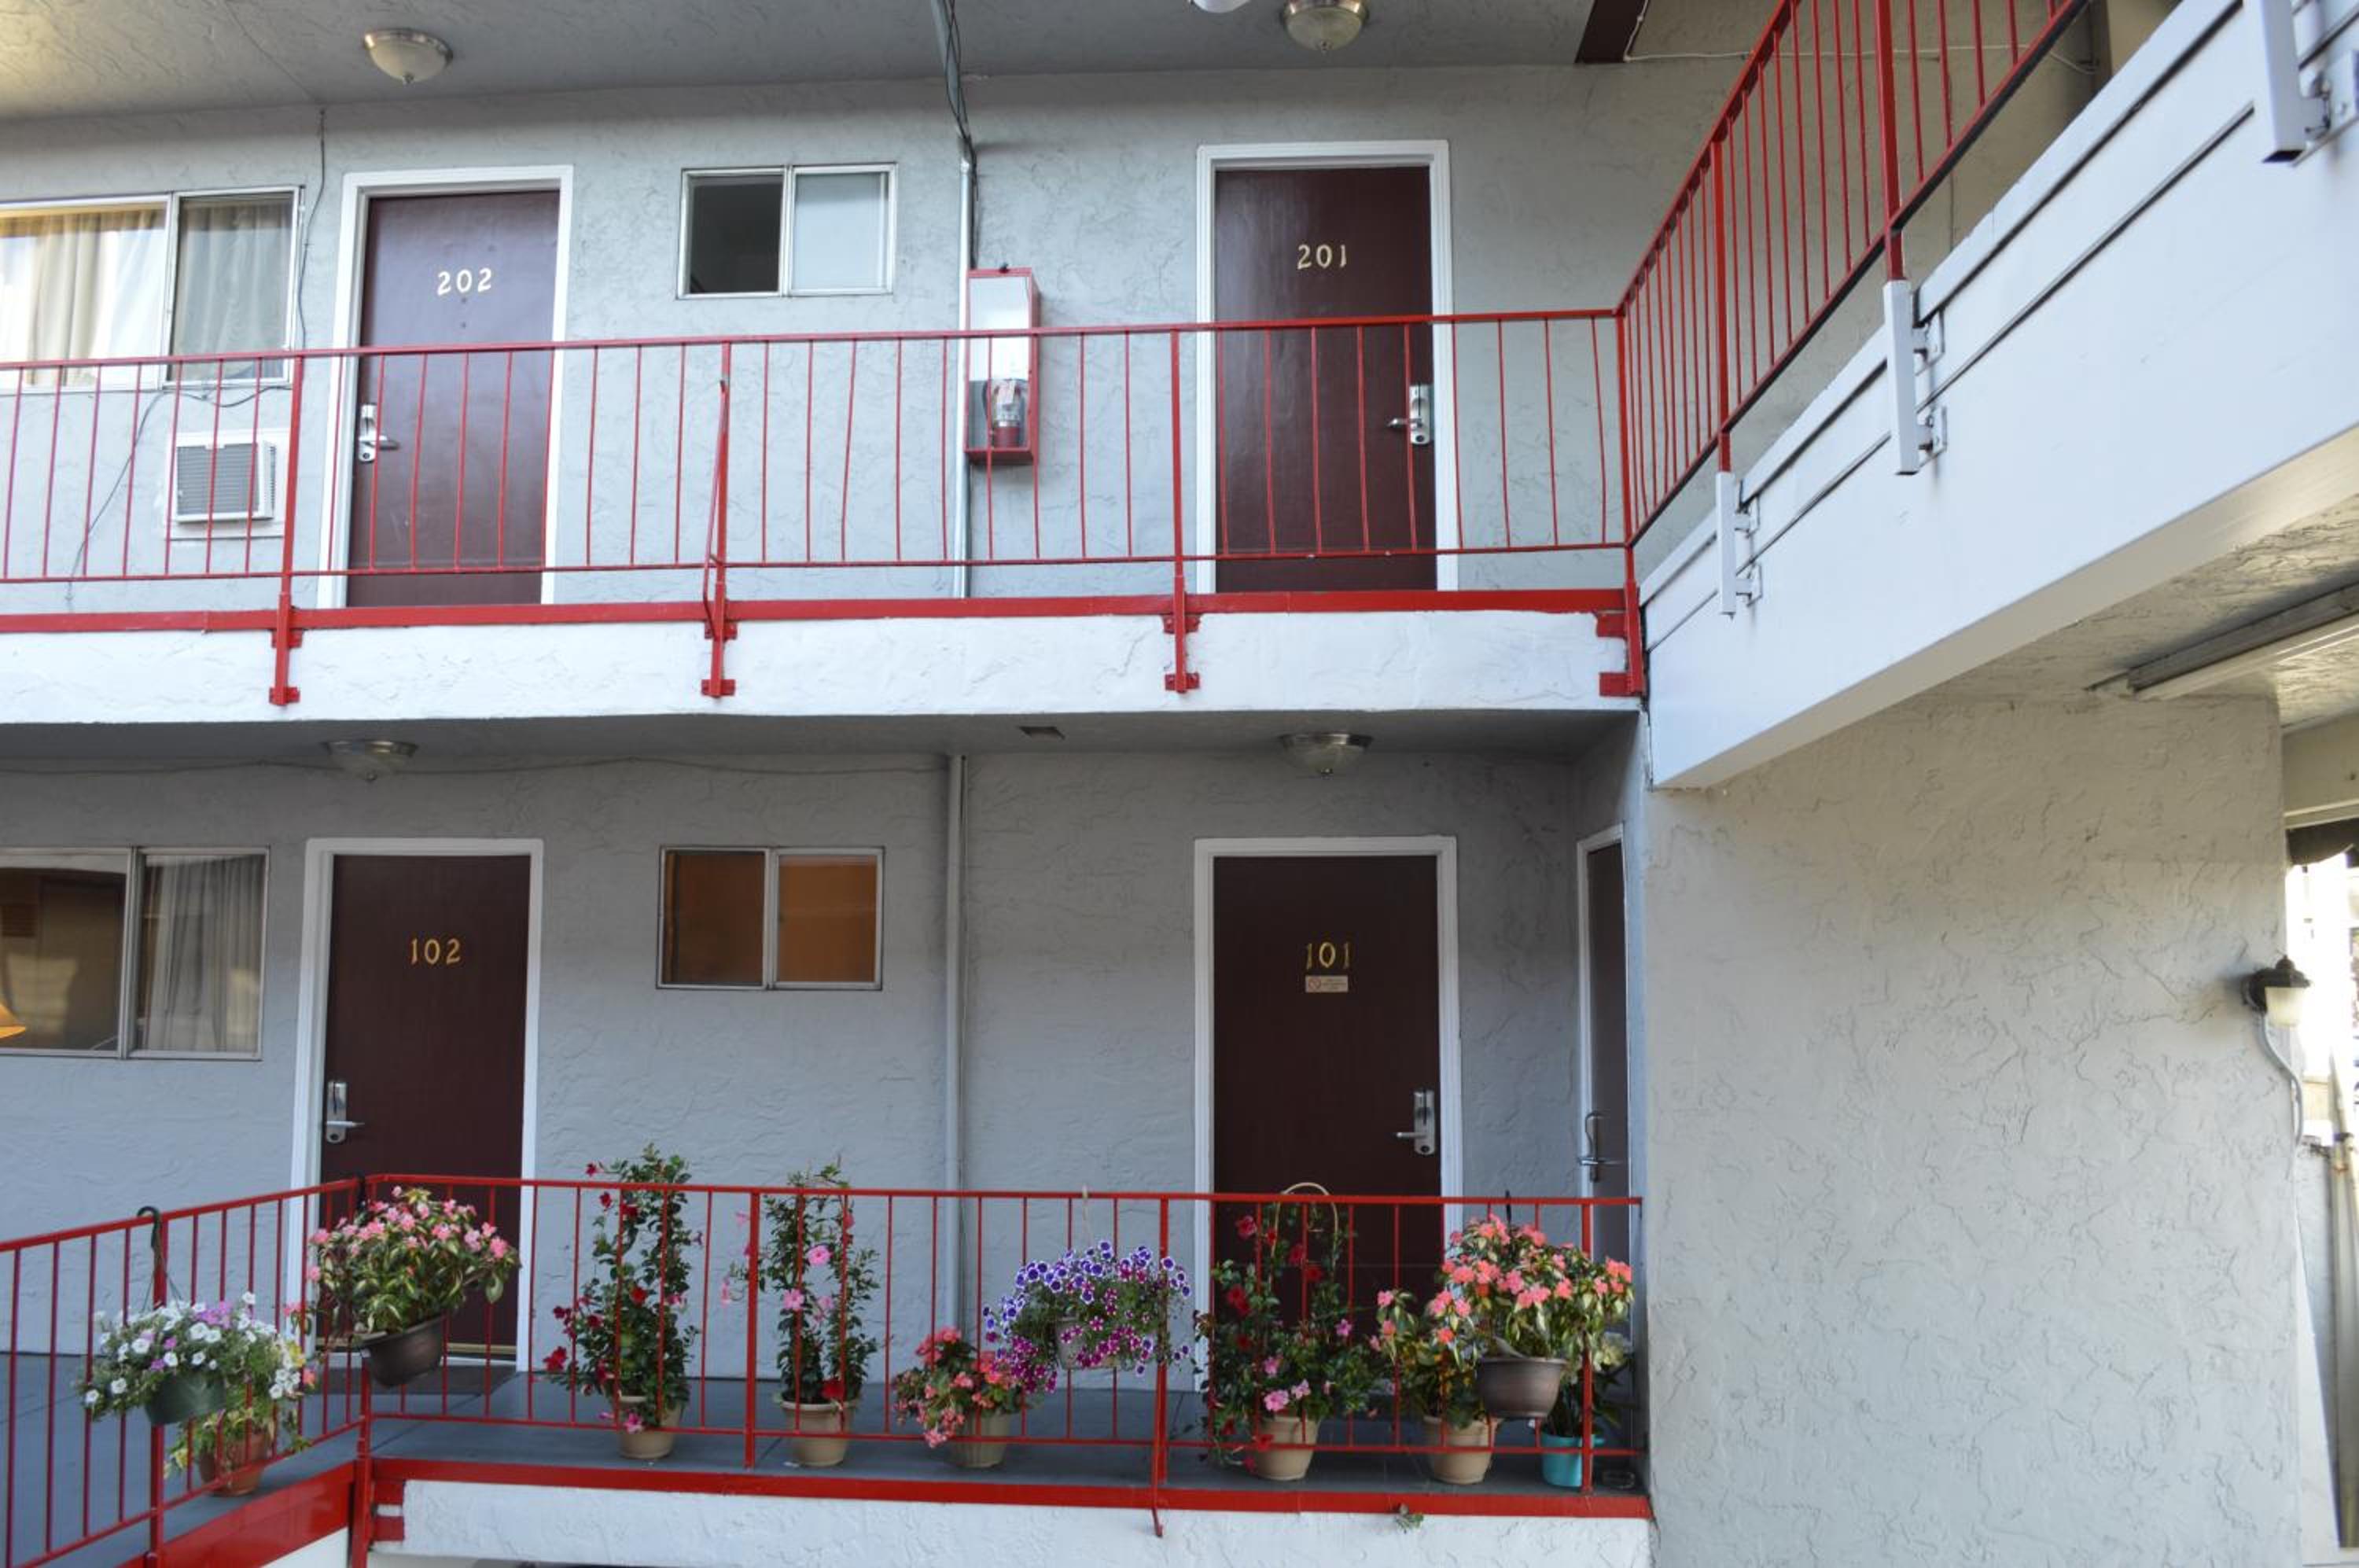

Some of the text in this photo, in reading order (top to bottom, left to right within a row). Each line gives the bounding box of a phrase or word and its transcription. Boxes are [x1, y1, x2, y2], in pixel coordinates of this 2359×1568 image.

[1297, 244, 1347, 270] 201
[437, 267, 492, 296] 202
[410, 937, 461, 965] 102
[1306, 941, 1350, 970] 101
